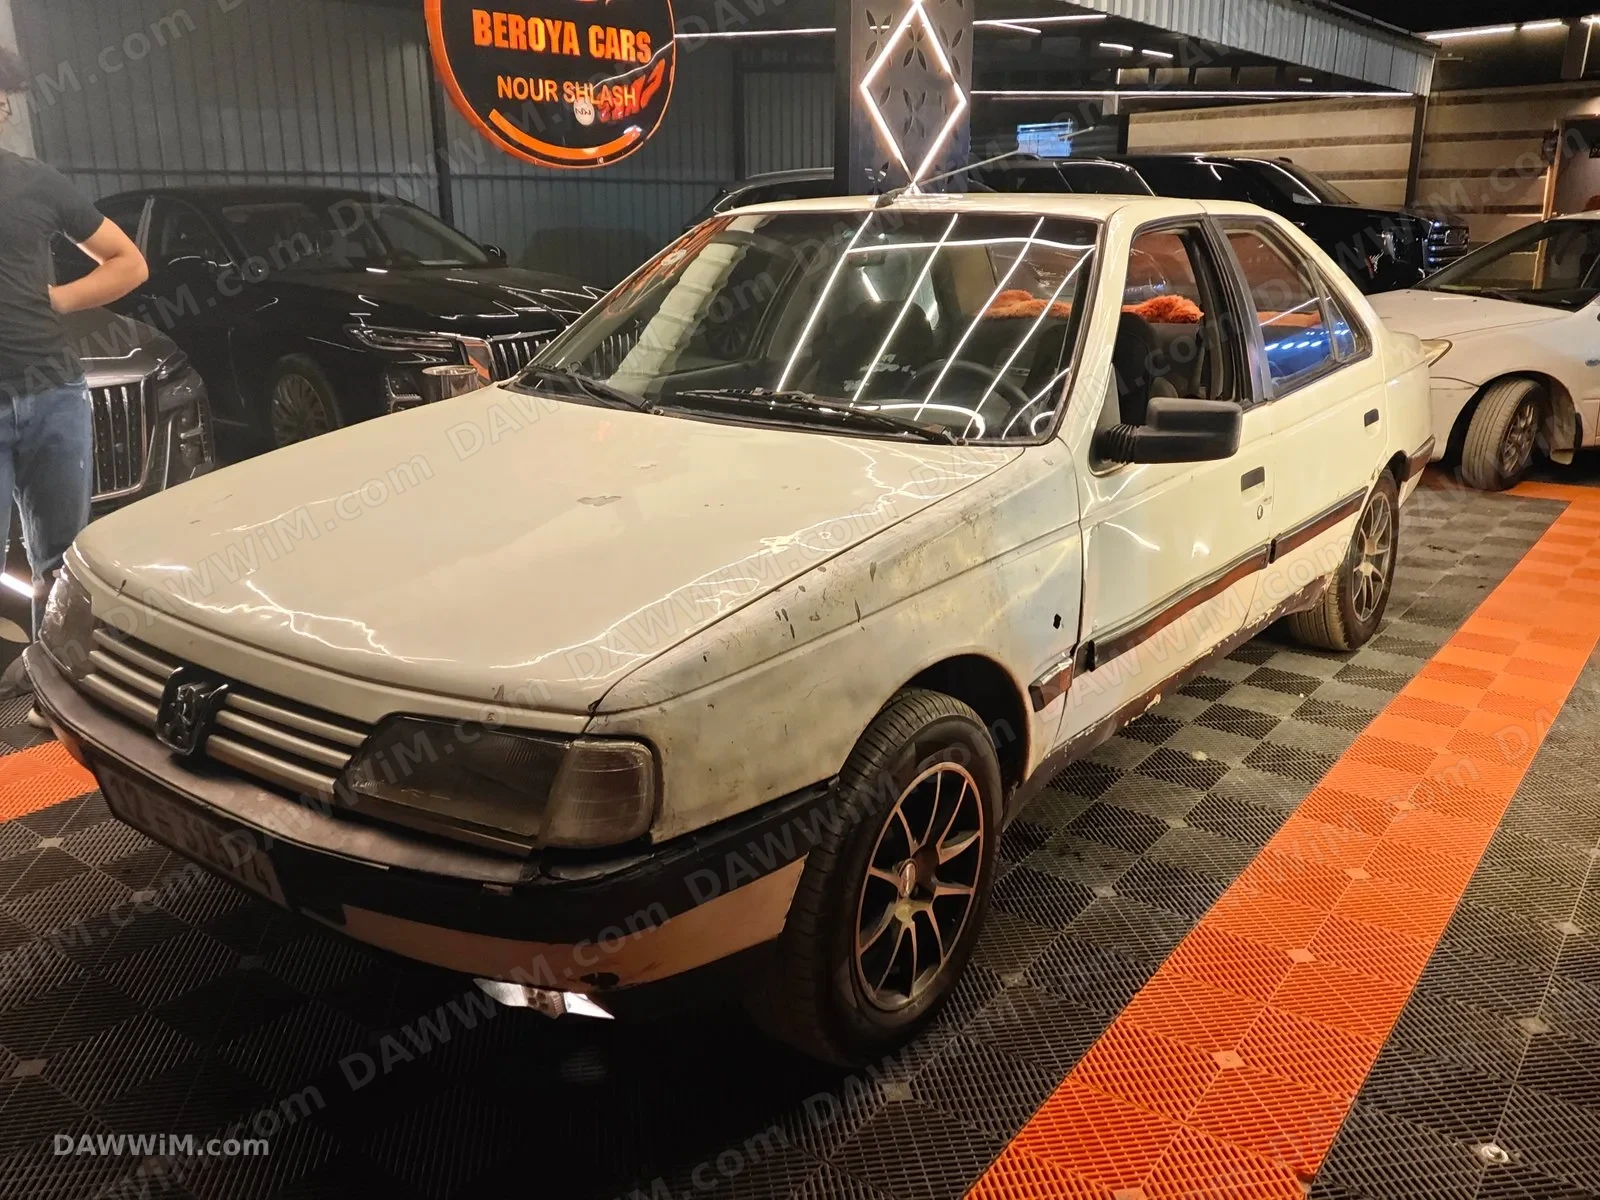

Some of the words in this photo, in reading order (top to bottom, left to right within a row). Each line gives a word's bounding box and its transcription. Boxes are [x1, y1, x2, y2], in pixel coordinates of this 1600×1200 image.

[472, 8, 580, 56] BEROYA
[588, 24, 652, 63] CARS
[496, 75, 558, 102] NOUR
[563, 81, 636, 107] SHLASH
